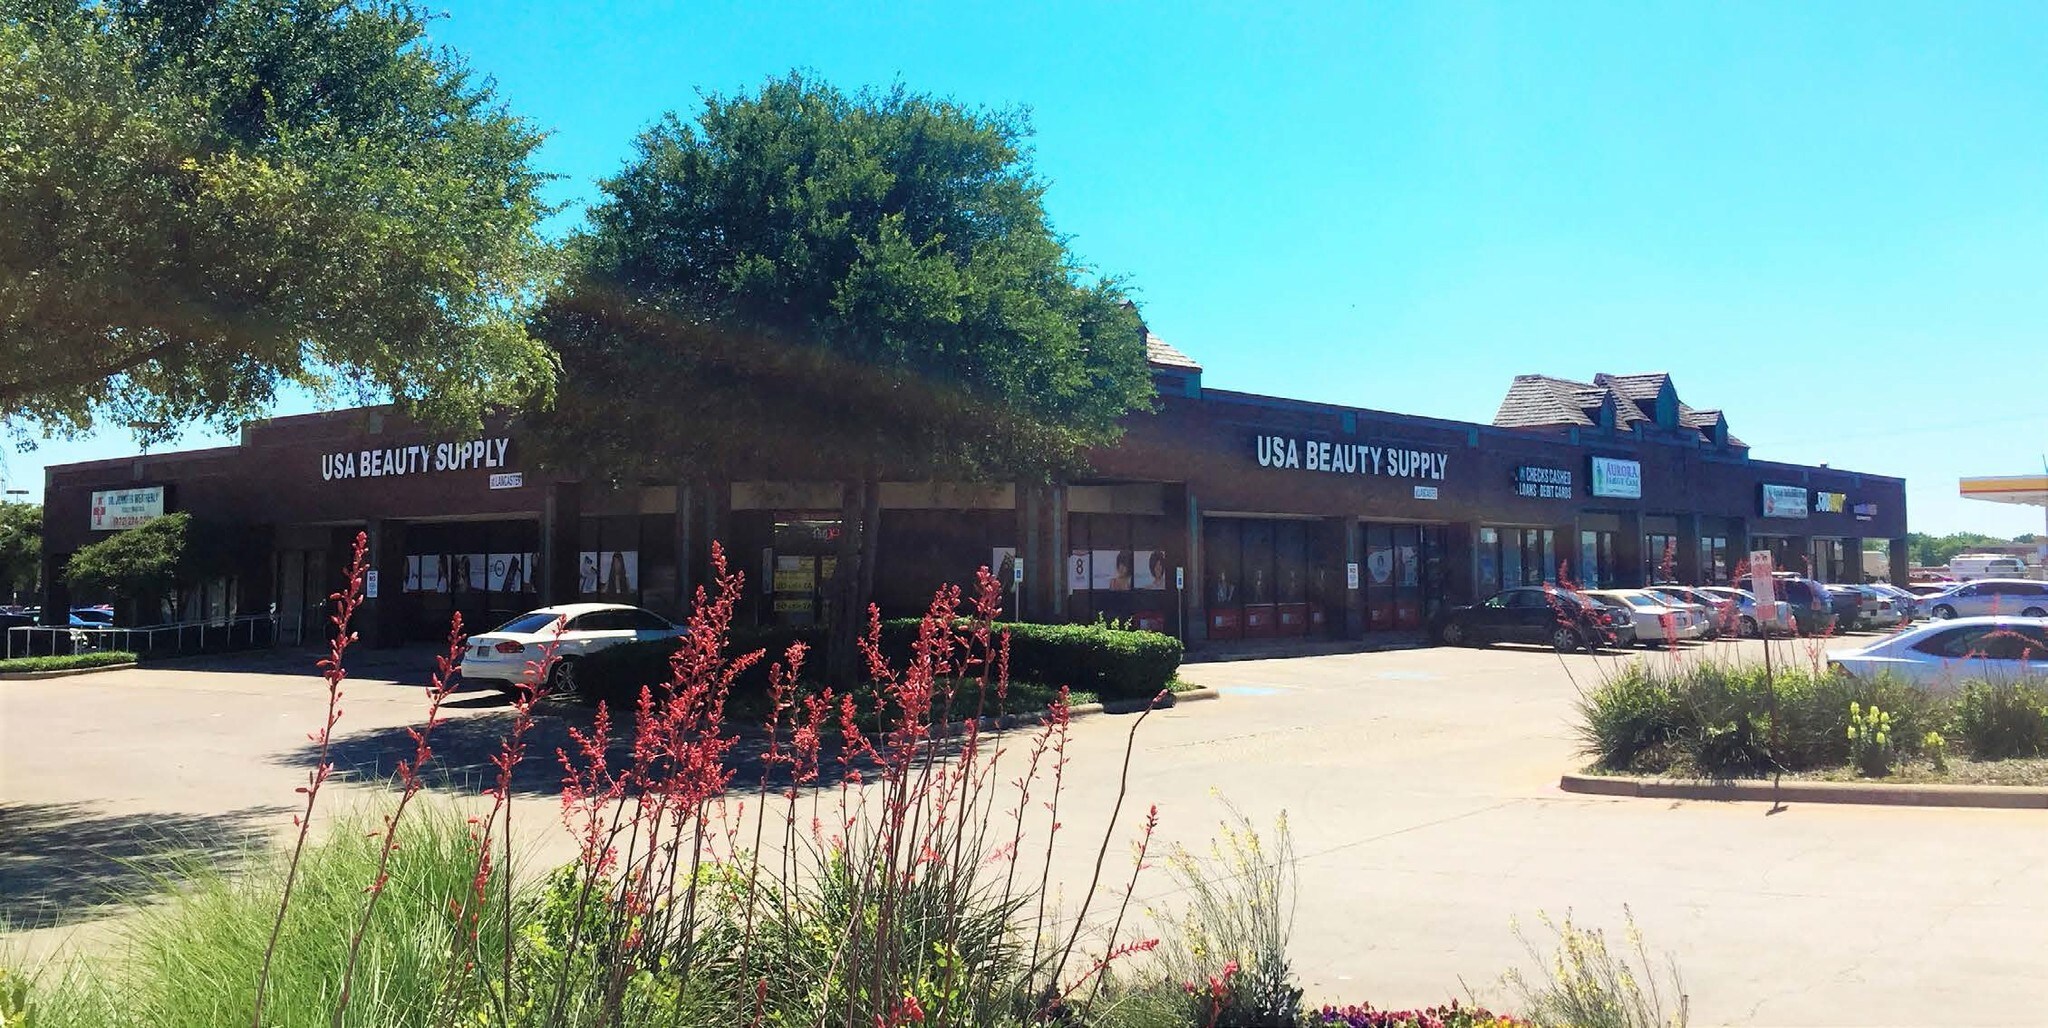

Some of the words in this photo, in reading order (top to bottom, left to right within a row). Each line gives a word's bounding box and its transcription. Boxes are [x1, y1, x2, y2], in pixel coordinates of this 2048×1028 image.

[321, 453, 356, 481] USA
[360, 445, 431, 477] BEAUTY
[435, 437, 509, 471] SUPPLY
[1257, 435, 1299, 469] USA
[1306, 440, 1382, 475] BEAUTY
[1387, 448, 1448, 480] SUPPLY
[1526, 467, 1549, 483] CHECKS
[1549, 468, 1572, 485] CASHED
[1607, 463, 1638, 478] AURORA
[496, 474, 522, 487] LANCASTER
[1519, 483, 1537, 497] LOANS
[1555, 485, 1572, 499] CARDS
